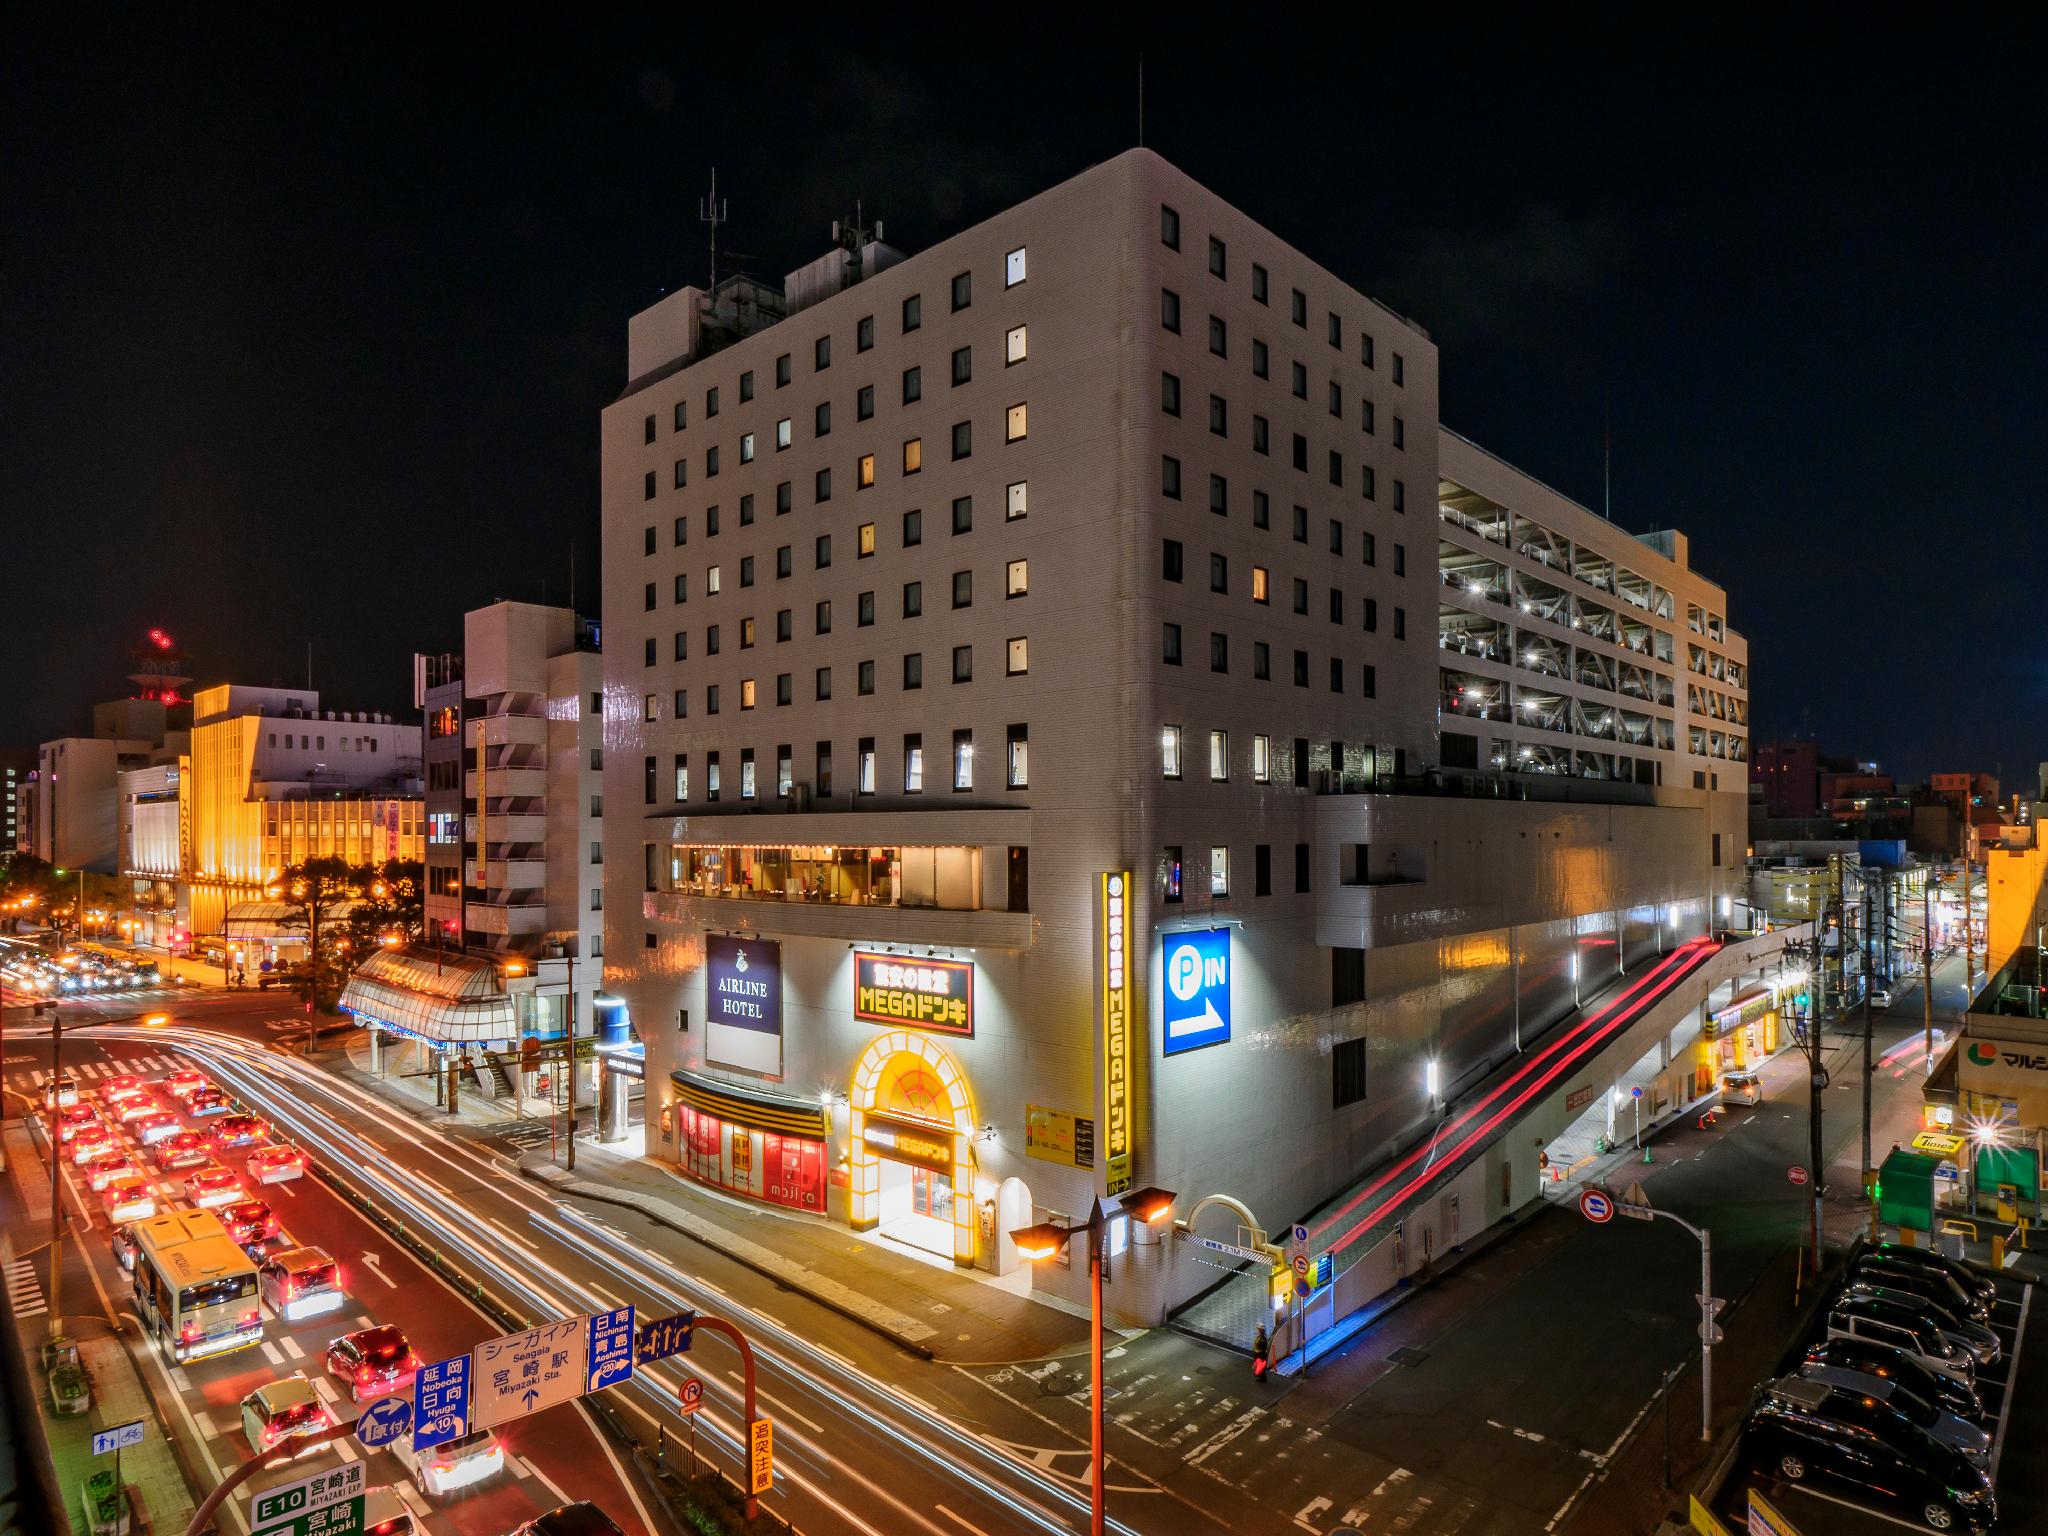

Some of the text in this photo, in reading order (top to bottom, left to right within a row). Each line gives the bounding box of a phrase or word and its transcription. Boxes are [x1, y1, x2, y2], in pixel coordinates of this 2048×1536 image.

[1204, 956, 1226, 988] IN
[718, 977, 768, 998] AIRLINE
[722, 999, 763, 1019] HOTEL
[859, 987, 967, 1025] MEGAドンキ
[1921, 1138, 1955, 1150] Times
[597, 1309, 629, 1330] 日南
[486, 1321, 578, 1361] シーガイア
[595, 1324, 629, 1340] Nichinan
[513, 1345, 551, 1363] Seagaia
[595, 1334, 628, 1354] 青島
[595, 1347, 628, 1363] Aoshima
[423, 1360, 463, 1383] 延岡
[493, 1350, 569, 1388] 宮崎駅
[601, 1362, 615, 1375] 220
[422, 1375, 463, 1393] Nobeoka
[499, 1370, 562, 1397] Miyazaki Sta.
[422, 1386, 462, 1410] 日向
[427, 1402, 457, 1418] Hyuga
[371, 1420, 404, 1441] 原付
[437, 1416, 451, 1429] 10
[755, 1423, 770, 1489] 追突注意
[310, 1466, 361, 1497] 宮崎道
[310, 1483, 362, 1507] MIYAZAKI EXP
[307, 1502, 353, 1531] 宮崎
